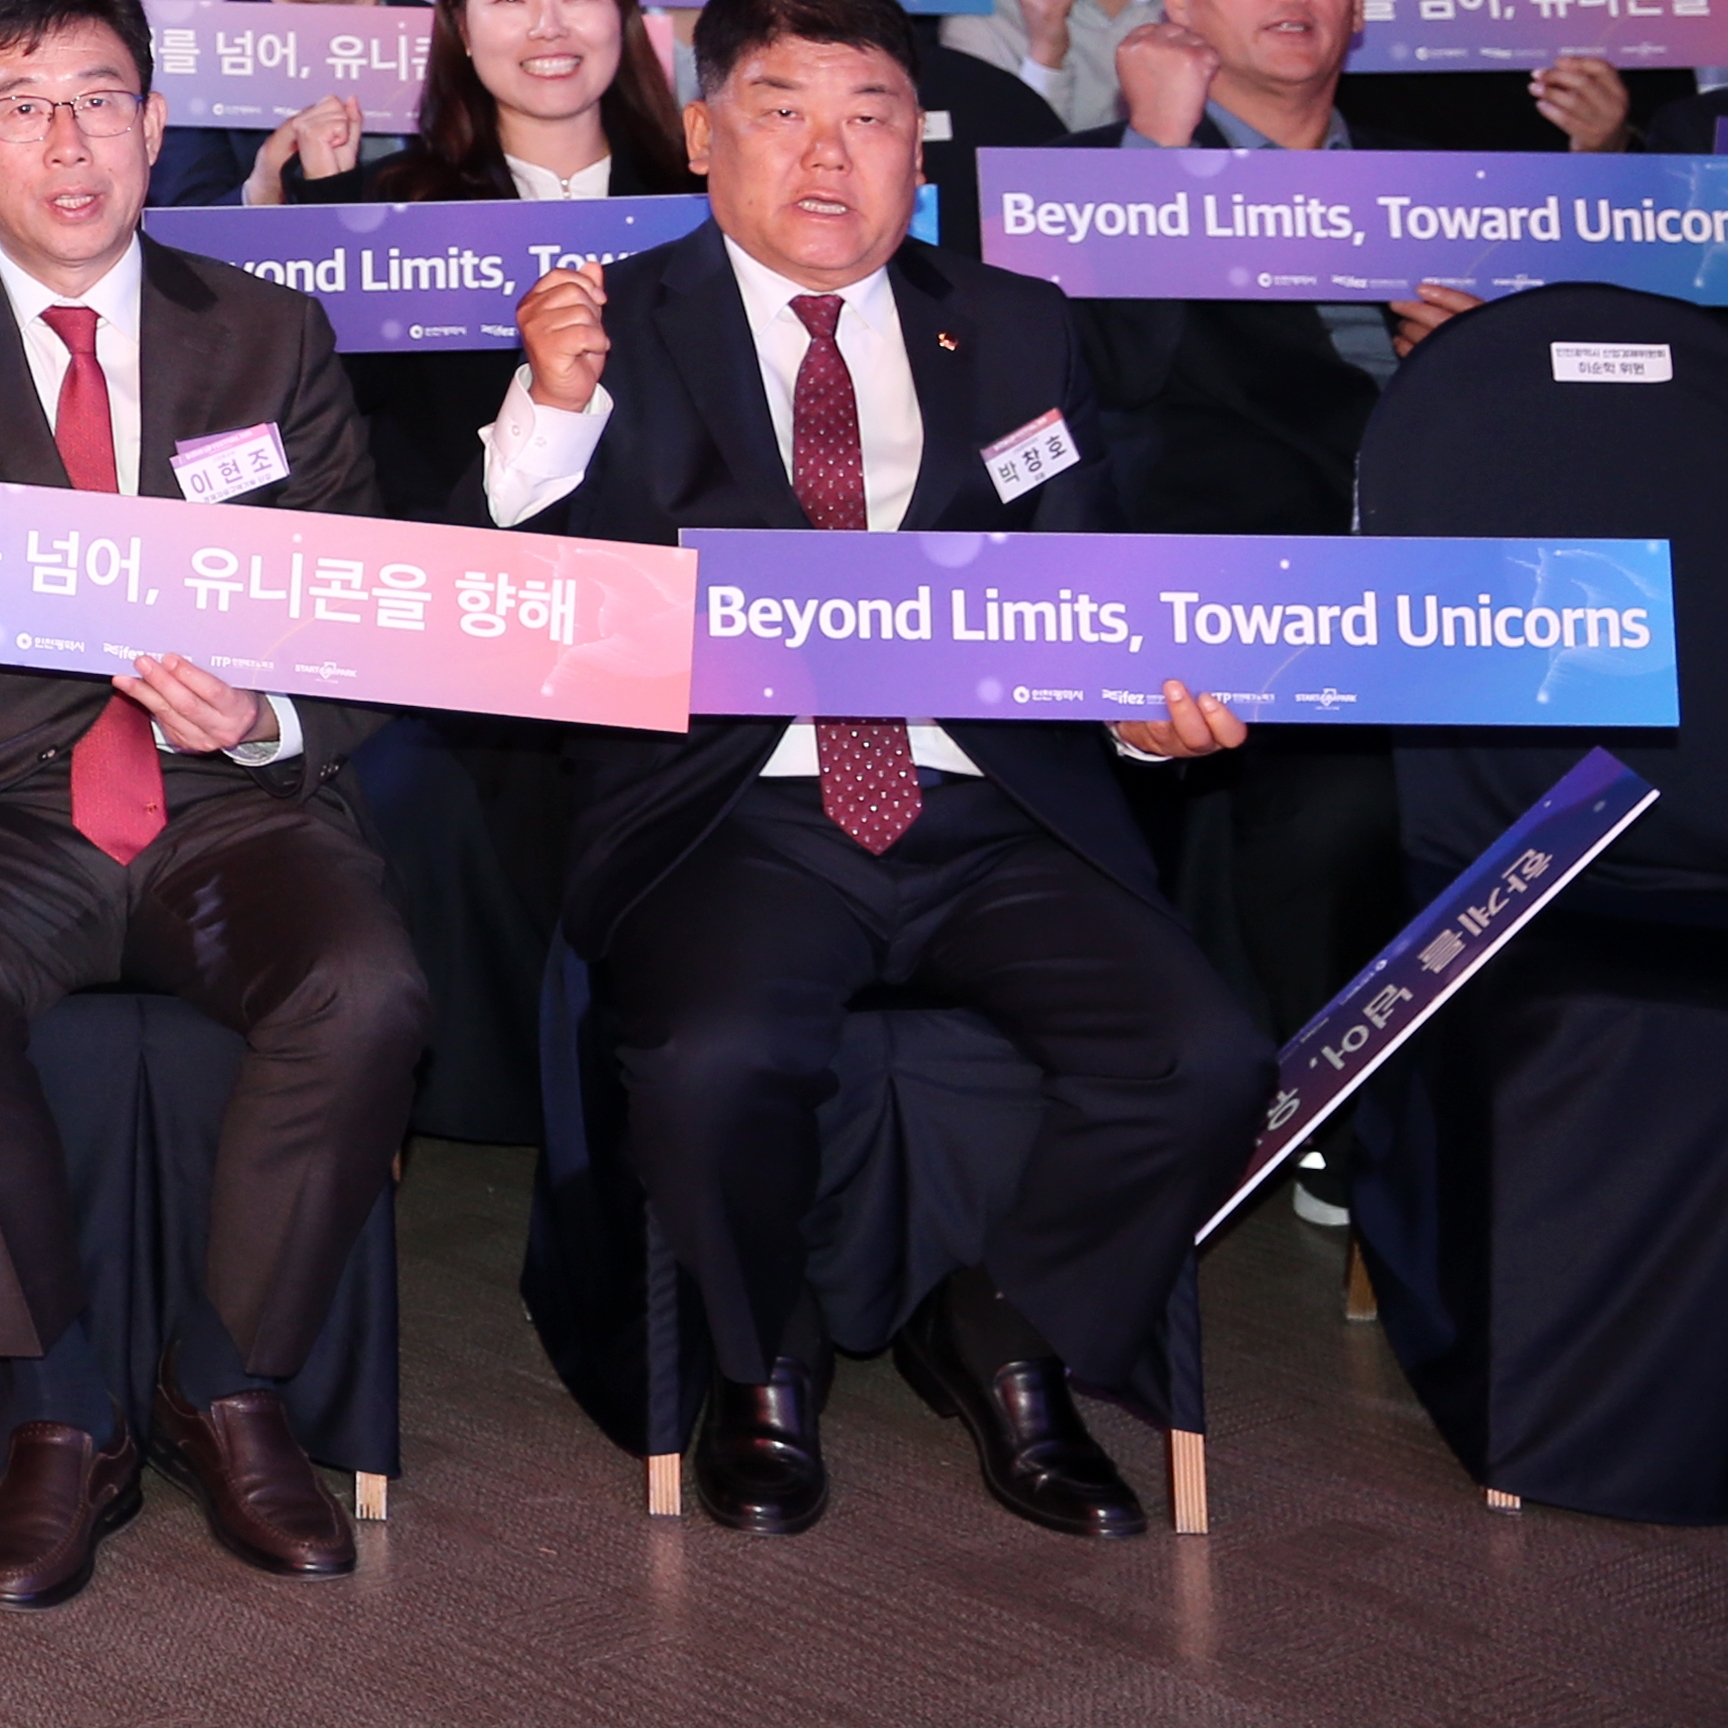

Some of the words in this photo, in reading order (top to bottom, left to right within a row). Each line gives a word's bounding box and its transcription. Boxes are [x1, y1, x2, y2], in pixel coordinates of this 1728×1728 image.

[215, 29, 310, 81] 넘어,
[1002, 191, 1170, 247] Beyond
[1223, 193, 1366, 247] Limits,
[1376, 195, 1561, 242] Toward
[361, 246, 517, 298] Limits,
[189, 447, 273, 495] 이현조
[998, 434, 1068, 484] 박창호
[24, 527, 160, 607] 넘어,
[183, 540, 434, 634] 유니콘을
[453, 569, 578, 647] 향해
[706, 582, 933, 649] Beyond
[949, 586, 1146, 653] Limits,
[1160, 590, 1379, 647] Toward
[1396, 593, 1650, 649] Unicorns
[210, 655, 232, 668] ITP
[1417, 848, 1554, 975] 한계를
[1308, 982, 1413, 1072] 넘어,
